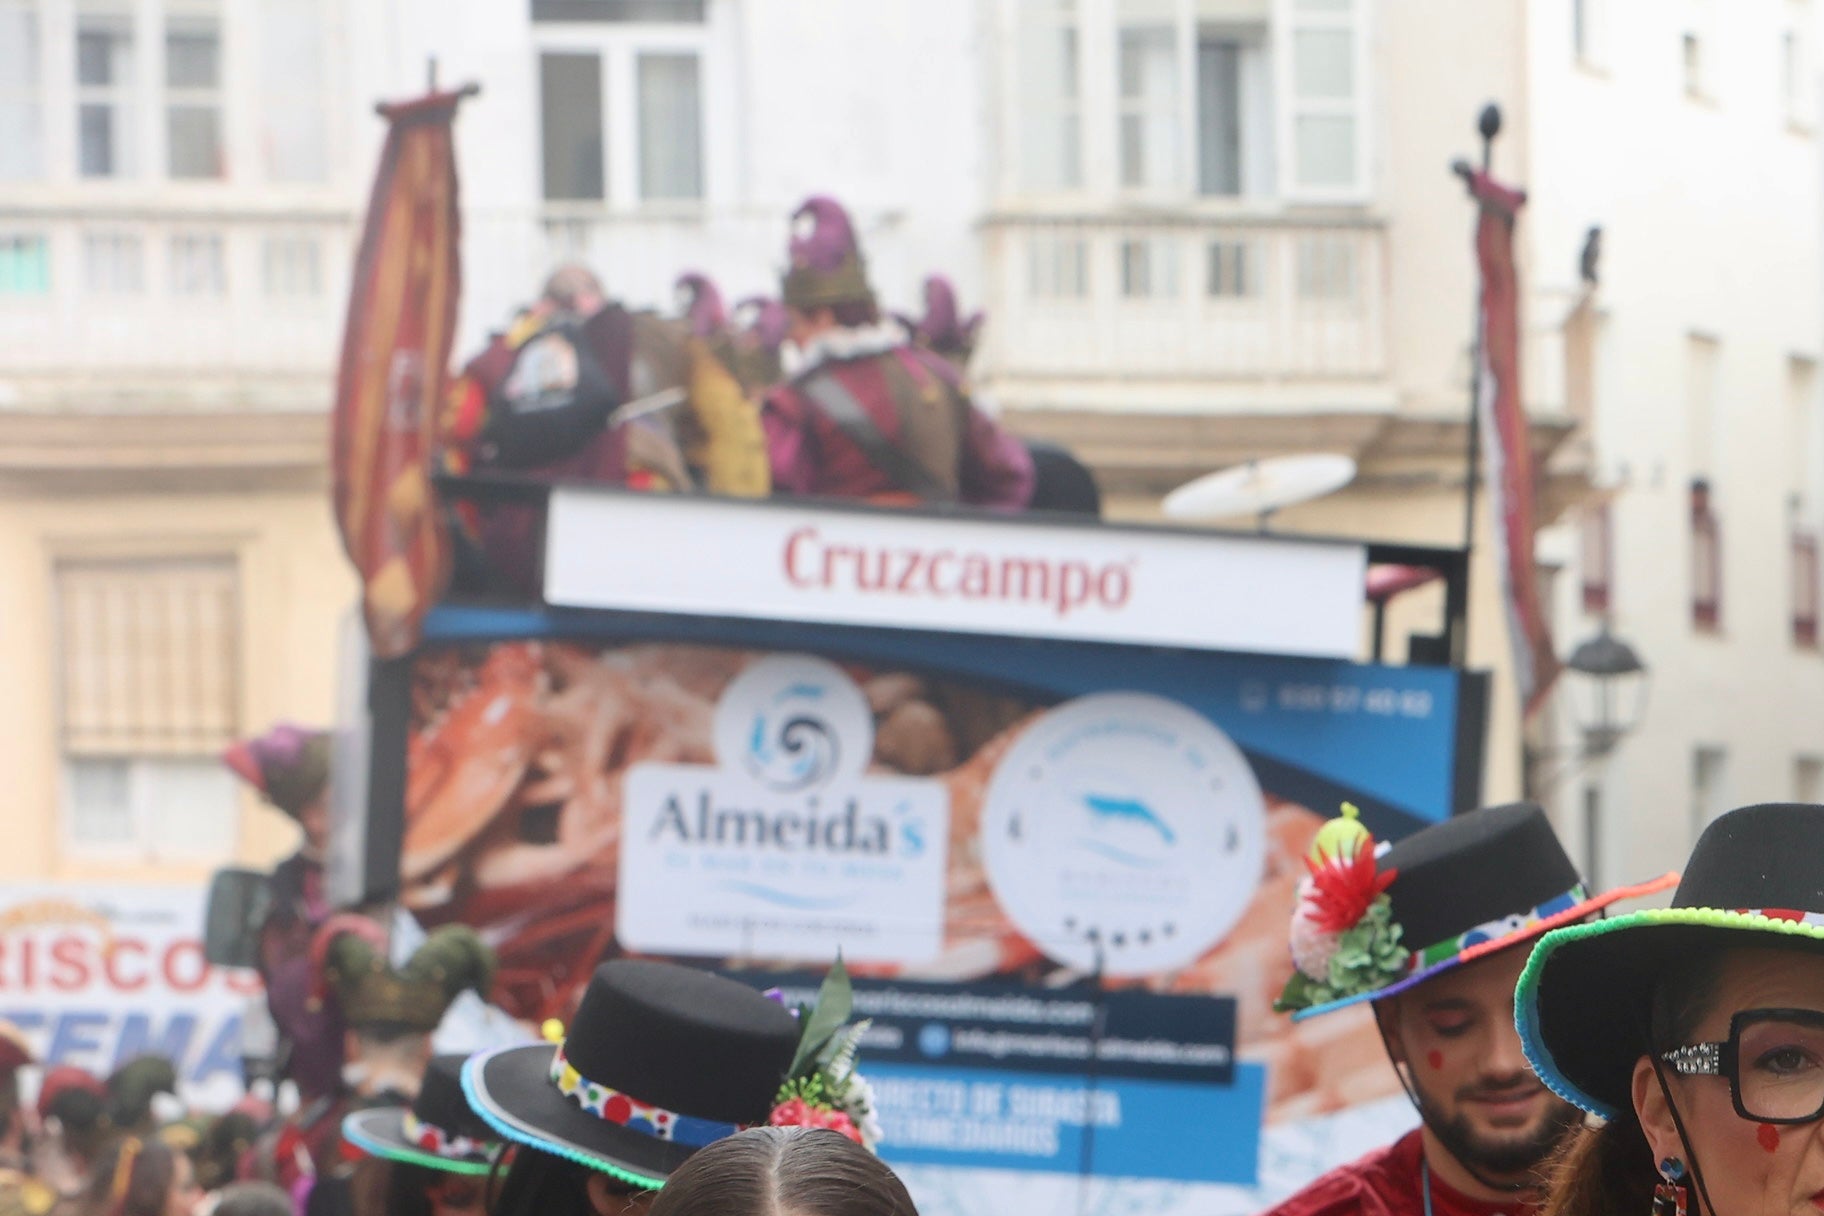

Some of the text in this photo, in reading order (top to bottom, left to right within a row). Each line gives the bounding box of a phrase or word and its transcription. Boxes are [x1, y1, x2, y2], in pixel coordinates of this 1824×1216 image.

[782, 522, 1134, 620] Cruzcampo
[0, 934, 265, 994] ISCO
[0, 1009, 246, 1082] EMA
